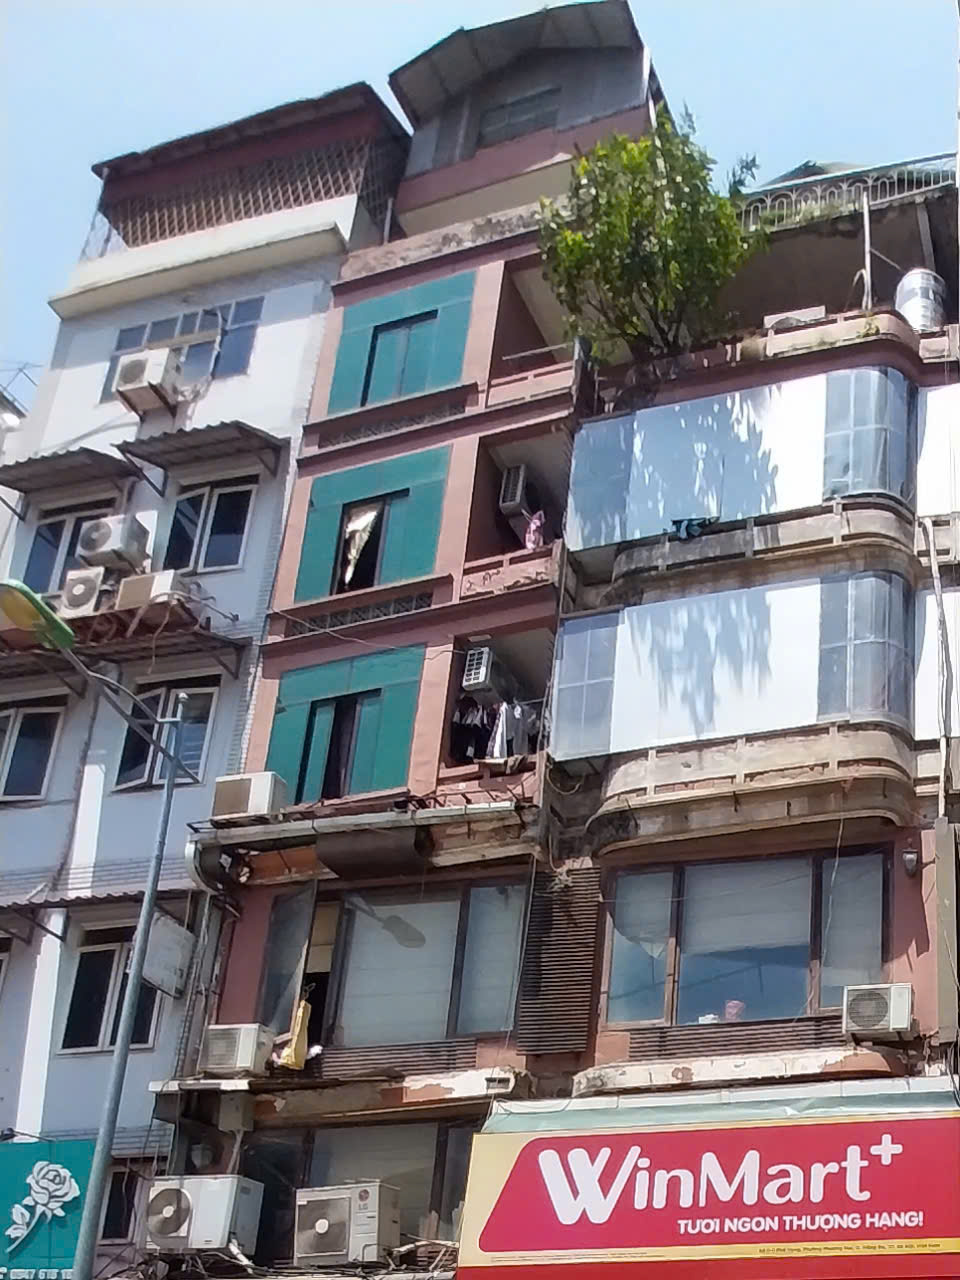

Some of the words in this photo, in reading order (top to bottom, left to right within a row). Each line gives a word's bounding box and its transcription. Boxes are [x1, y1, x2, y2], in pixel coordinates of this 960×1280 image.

[723, 1215, 779, 1234] NGON
[782, 1213, 862, 1233] THƯỢNG
[865, 1211, 924, 1231] HẠNG!
